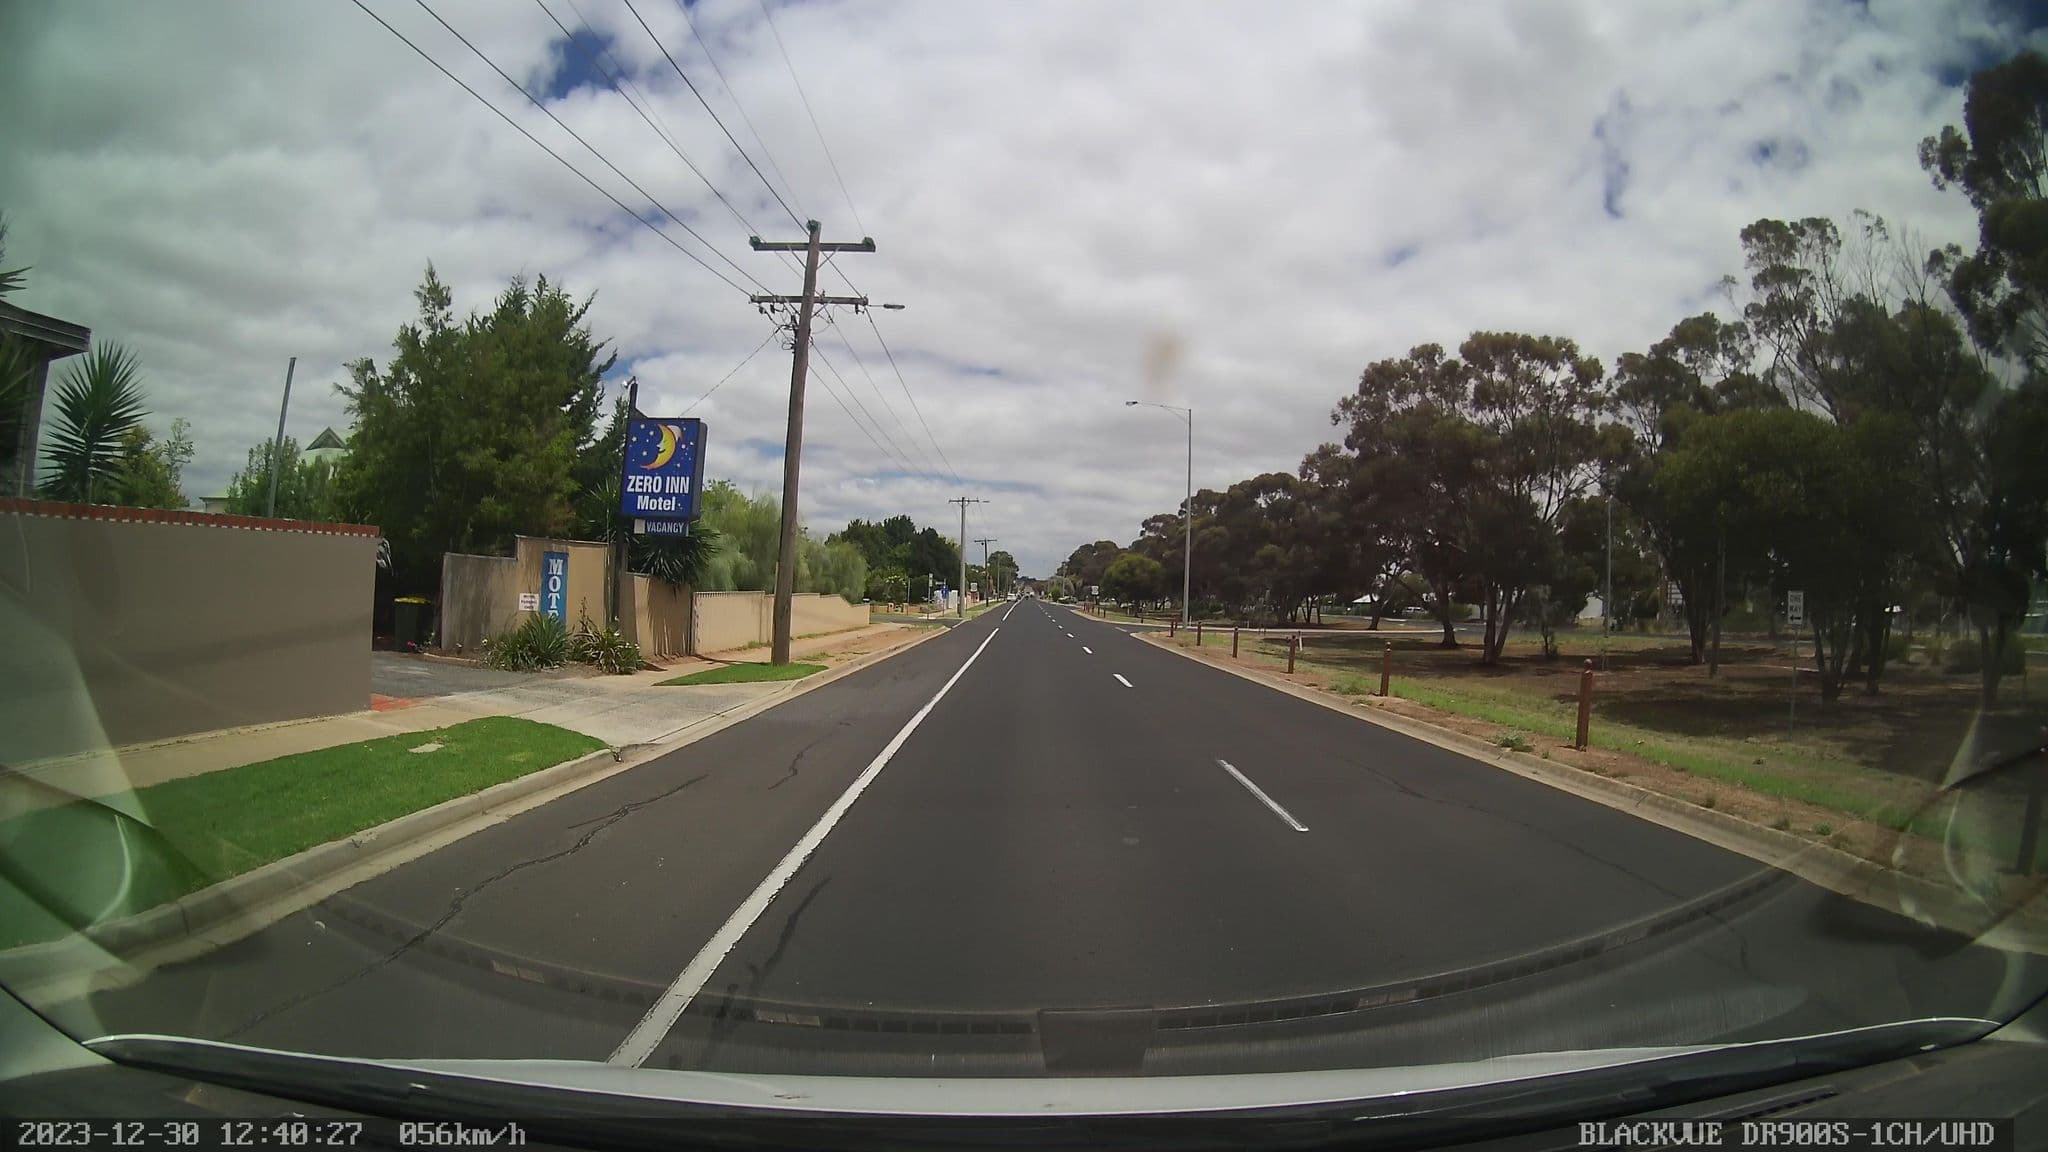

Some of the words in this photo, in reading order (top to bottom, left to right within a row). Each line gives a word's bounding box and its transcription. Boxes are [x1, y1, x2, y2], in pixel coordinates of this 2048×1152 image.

[627, 475, 662, 493] ZERO
[665, 476, 690, 494] INN
[637, 495, 676, 511] Motel
[646, 521, 684, 533] VACANCY
